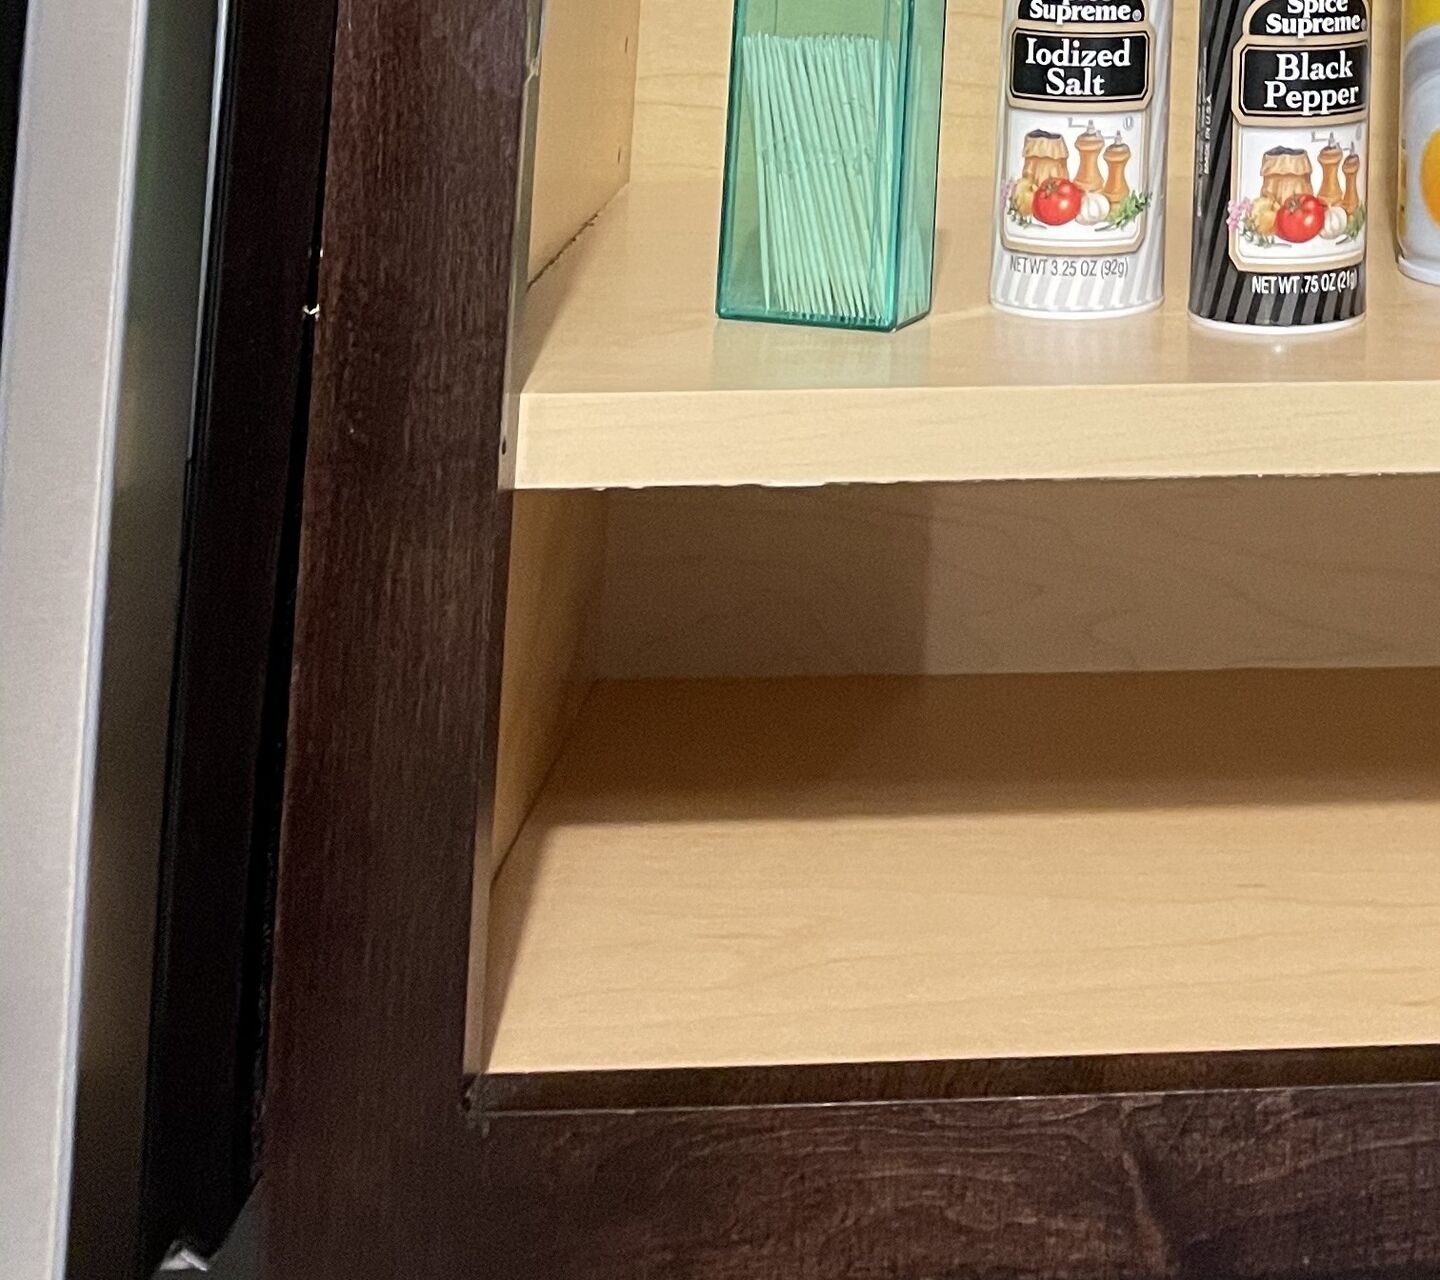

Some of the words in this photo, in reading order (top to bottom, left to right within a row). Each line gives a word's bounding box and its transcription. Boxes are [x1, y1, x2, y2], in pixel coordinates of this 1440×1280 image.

[1266, 13, 1361, 39] Supreme
[1025, 37, 1131, 67] Iodized
[1275, 50, 1353, 81] Black
[1046, 67, 1105, 96] Salt
[1264, 80, 1359, 116] Pepper
[1010, 255, 1028, 274] NET
[1030, 258, 1047, 276] WT
[1051, 260, 1077, 276] 3.25
[1080, 260, 1098, 277] OZ
[1100, 257, 1129, 279] (92g)
[1252, 276, 1277, 294] NET
[1278, 276, 1300, 294] WT
[1300, 274, 1319, 294] .75
[1321, 272, 1337, 292] OZ
